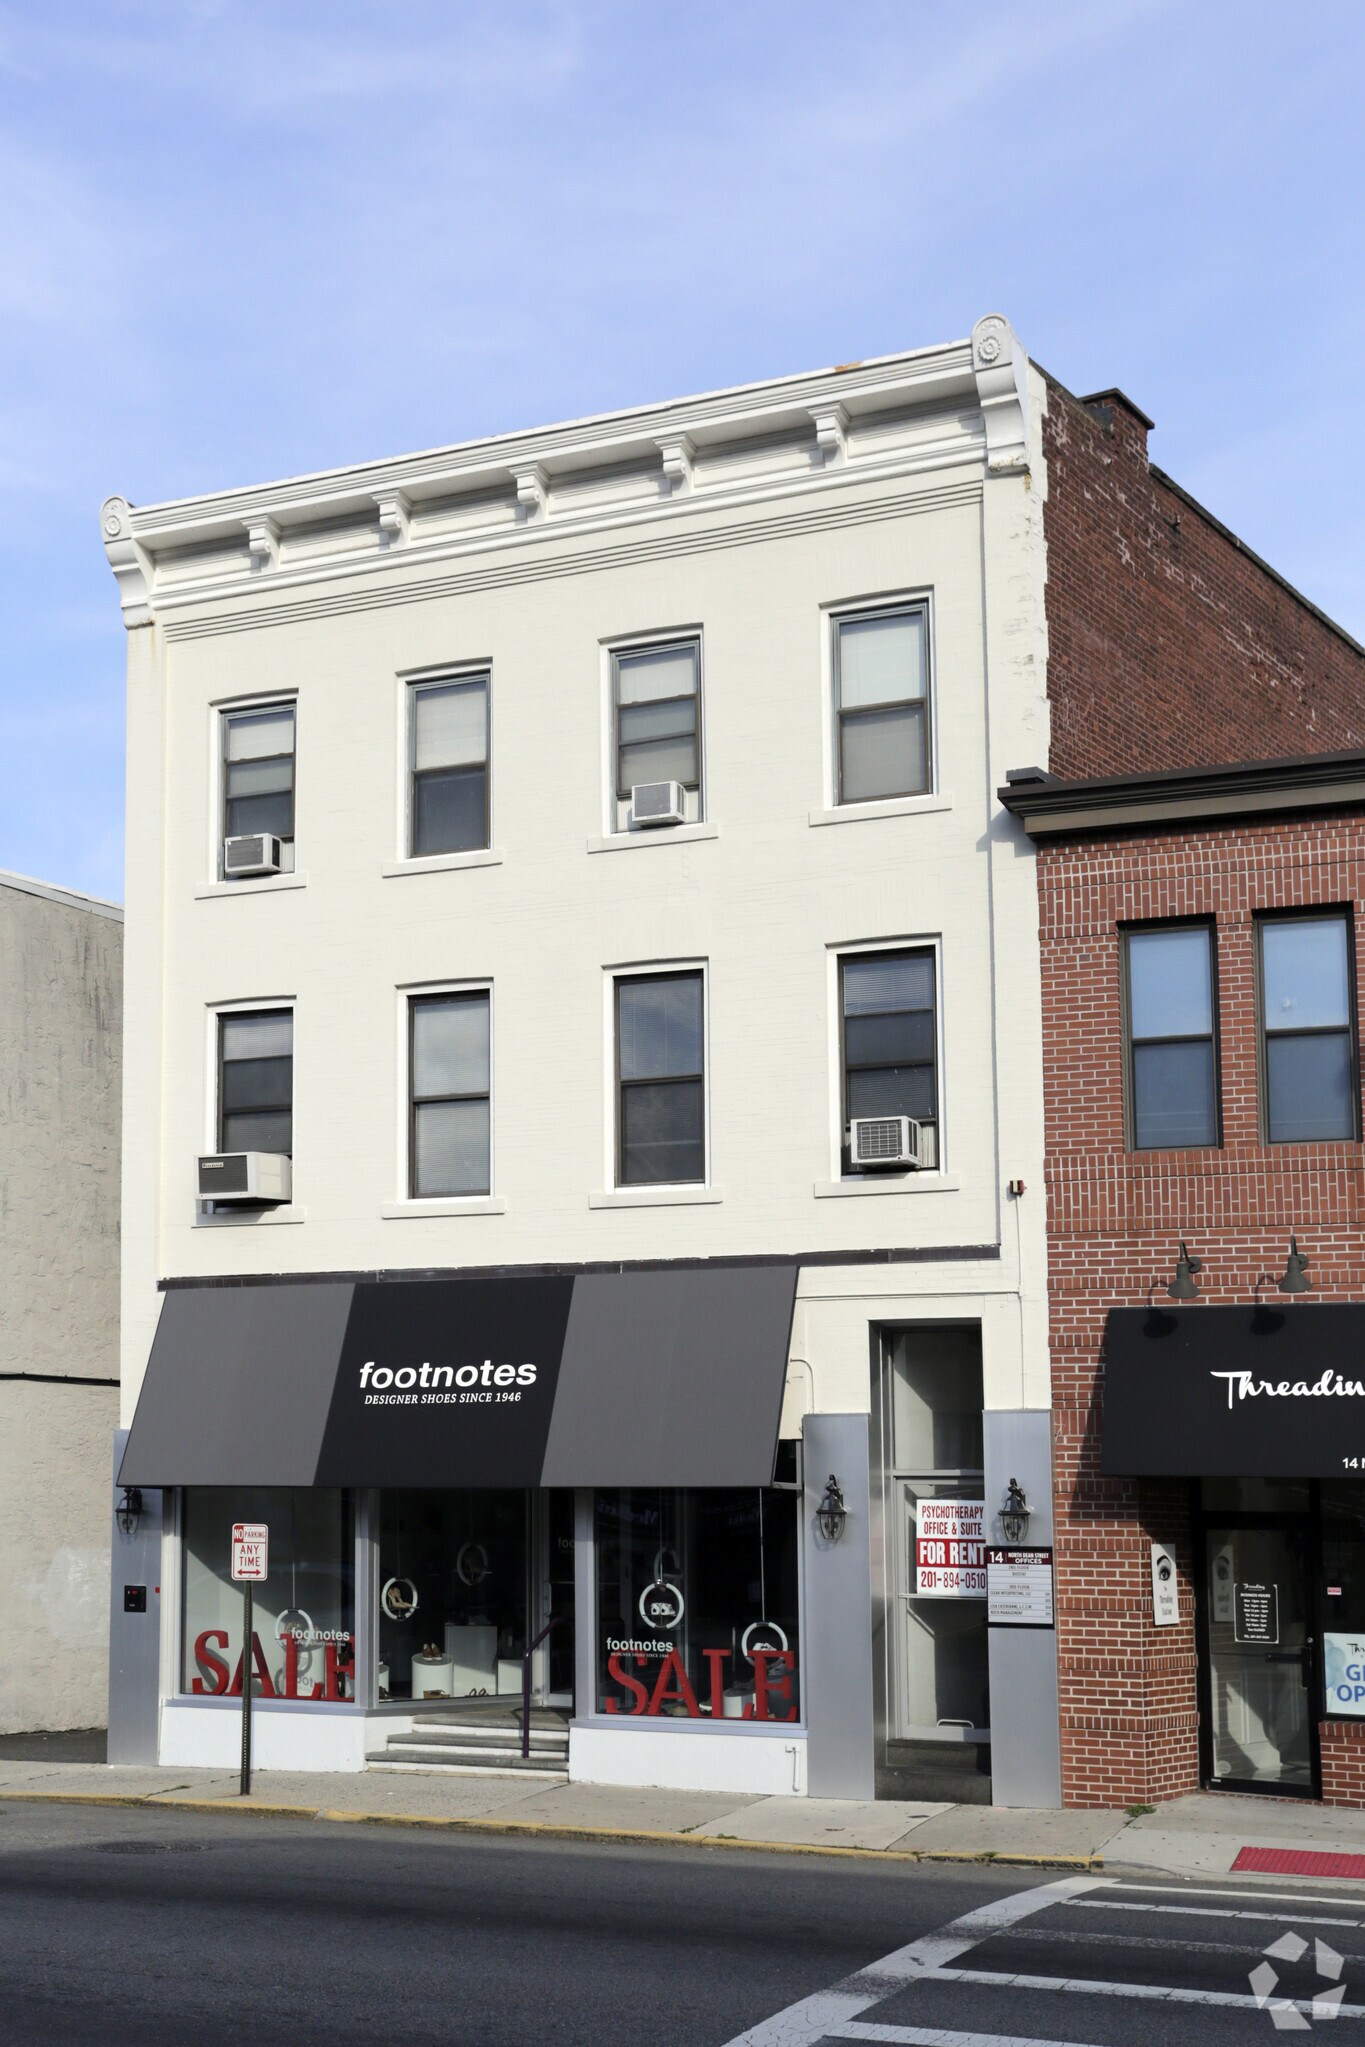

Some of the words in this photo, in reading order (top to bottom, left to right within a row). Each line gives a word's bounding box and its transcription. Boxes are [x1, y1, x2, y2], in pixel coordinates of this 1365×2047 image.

[359, 1360, 537, 1389] footnotes
[364, 1394, 418, 1405] DESIGNER
[421, 1393, 457, 1404] SHOES
[459, 1392, 492, 1403] SINCE
[495, 1392, 522, 1402] 1946
[1342, 1457, 1358, 1469] 14
[921, 1505, 984, 1519] PSYCHOTHERAPY
[234, 1528, 244, 1540] NO
[245, 1531, 266, 1539] PARKING
[923, 1521, 948, 1535] OFFICE
[951, 1522, 957, 1535] &
[960, 1522, 982, 1536] SUITE
[240, 1544, 260, 1554] ANY
[920, 1541, 946, 1565] FOR
[949, 1541, 986, 1566] RENT
[239, 1556, 260, 1567] TIME
[989, 1551, 1004, 1564] 14
[921, 1571, 986, 1589] 201-894-0510
[291, 1627, 350, 1641] footnotes
[606, 1637, 674, 1652] footnotes
[1346, 1663, 1365, 1682] G
[605, 1646, 797, 1722] SALE
